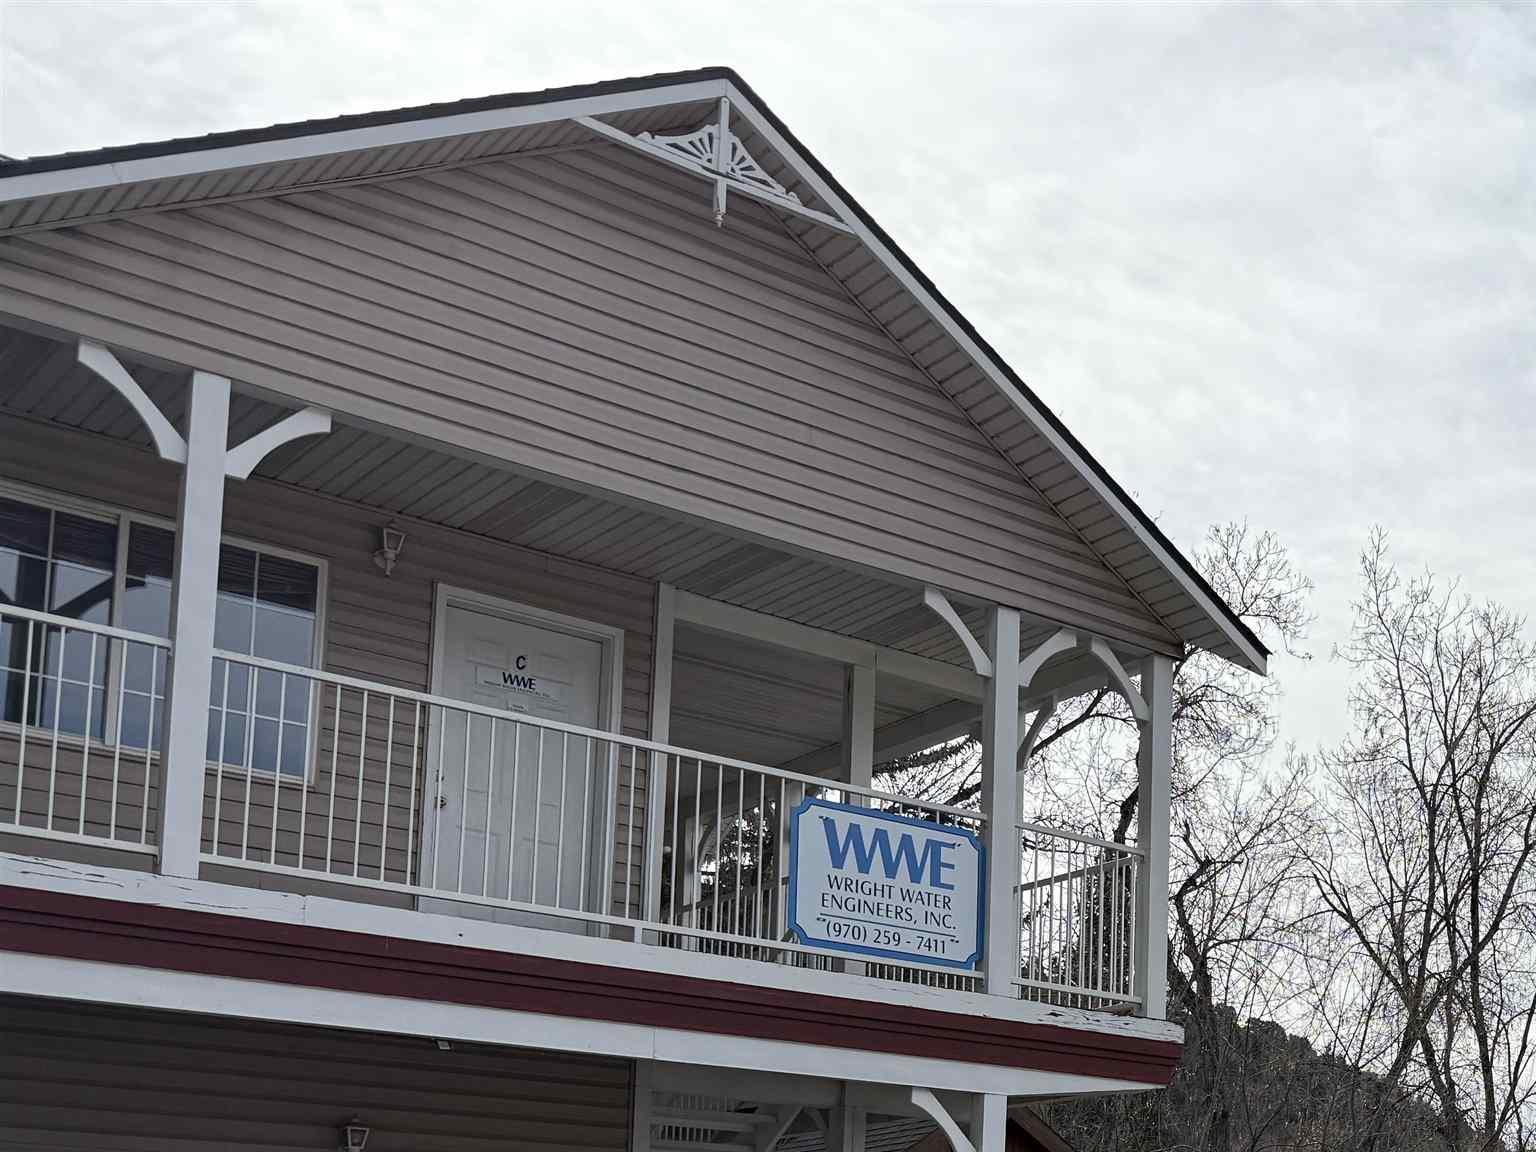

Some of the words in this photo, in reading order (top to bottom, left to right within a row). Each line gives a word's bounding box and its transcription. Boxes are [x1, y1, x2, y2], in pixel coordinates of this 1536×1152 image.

[515, 655, 527, 670] C
[502, 672, 537, 690] WWE
[822, 817, 956, 890] WWE
[827, 874, 895, 900] WRIGHT
[900, 887, 952, 910] WATER
[821, 892, 919, 925] ENGINEERS,
[924, 910, 957, 930] INC.
[826, 922, 867, 943] (970)
[873, 929, 901, 947] 259
[917, 935, 946, 954] 7411
